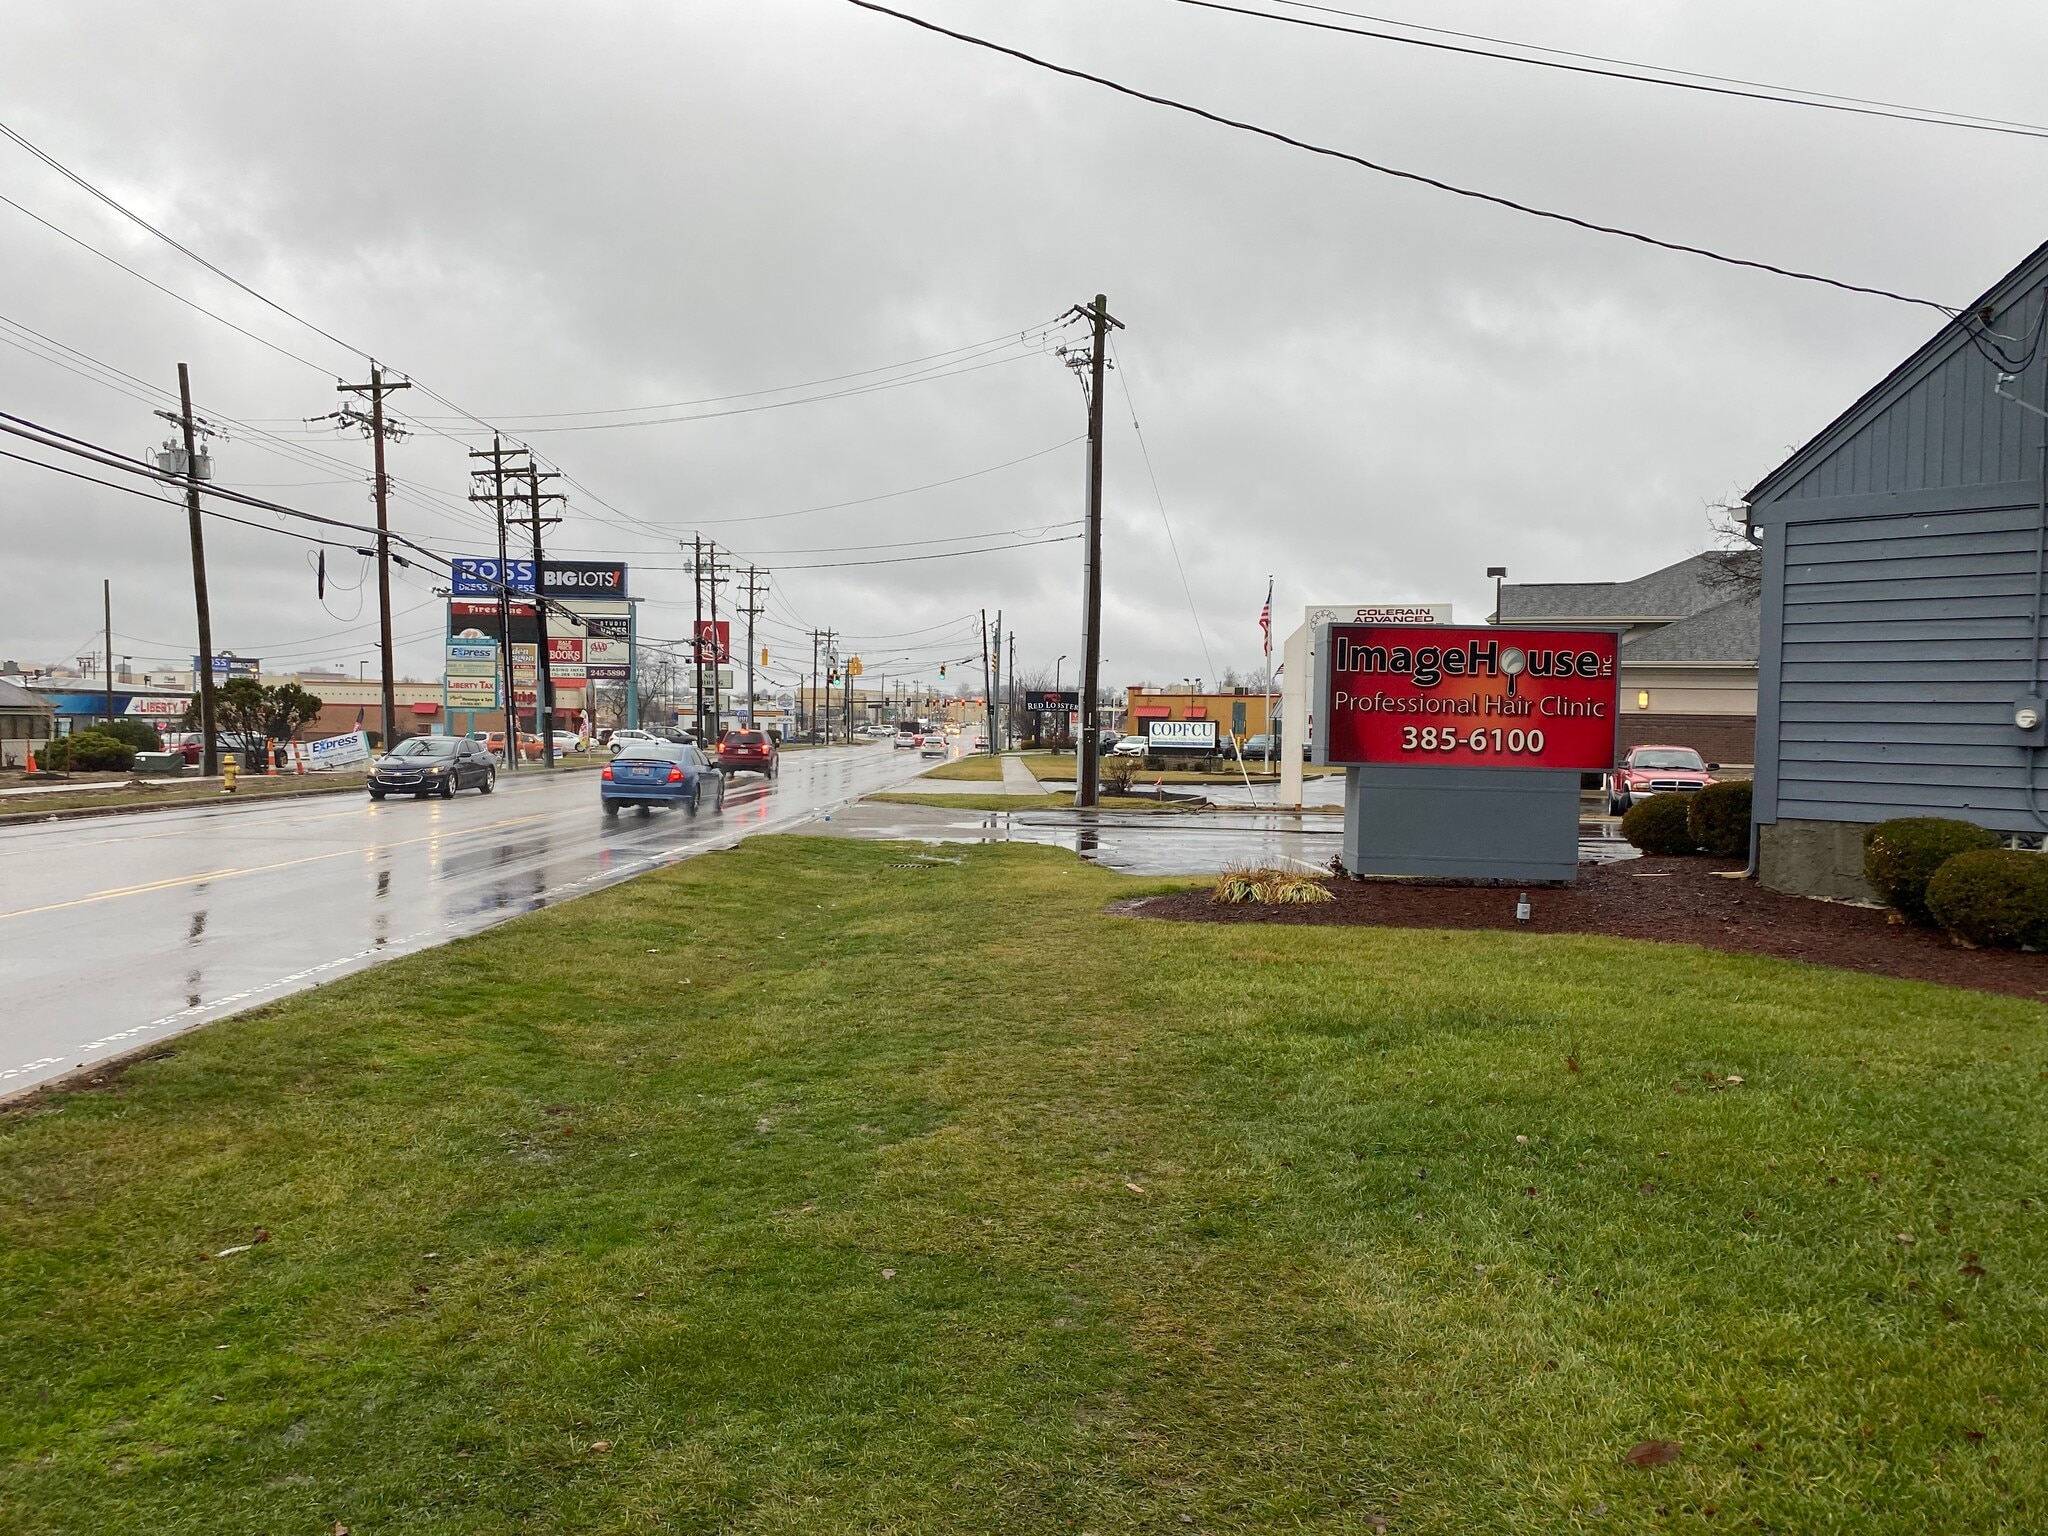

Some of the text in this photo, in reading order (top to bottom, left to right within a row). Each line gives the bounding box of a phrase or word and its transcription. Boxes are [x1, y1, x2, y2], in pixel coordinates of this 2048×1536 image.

[462, 561, 532, 580] ROSS
[467, 604, 522, 615] Firesne
[1357, 608, 1431, 616] COLERAIN
[1353, 615, 1435, 623] ADVANCED
[549, 650, 580, 661] BOOKS
[590, 669, 626, 677] 245-5890
[1027, 701, 1079, 711] RED LOBSTER
[1334, 691, 1605, 718] Professional Hair Clinic
[1151, 723, 1214, 737] COPFCU
[1401, 726, 1545, 752] 385-6100
